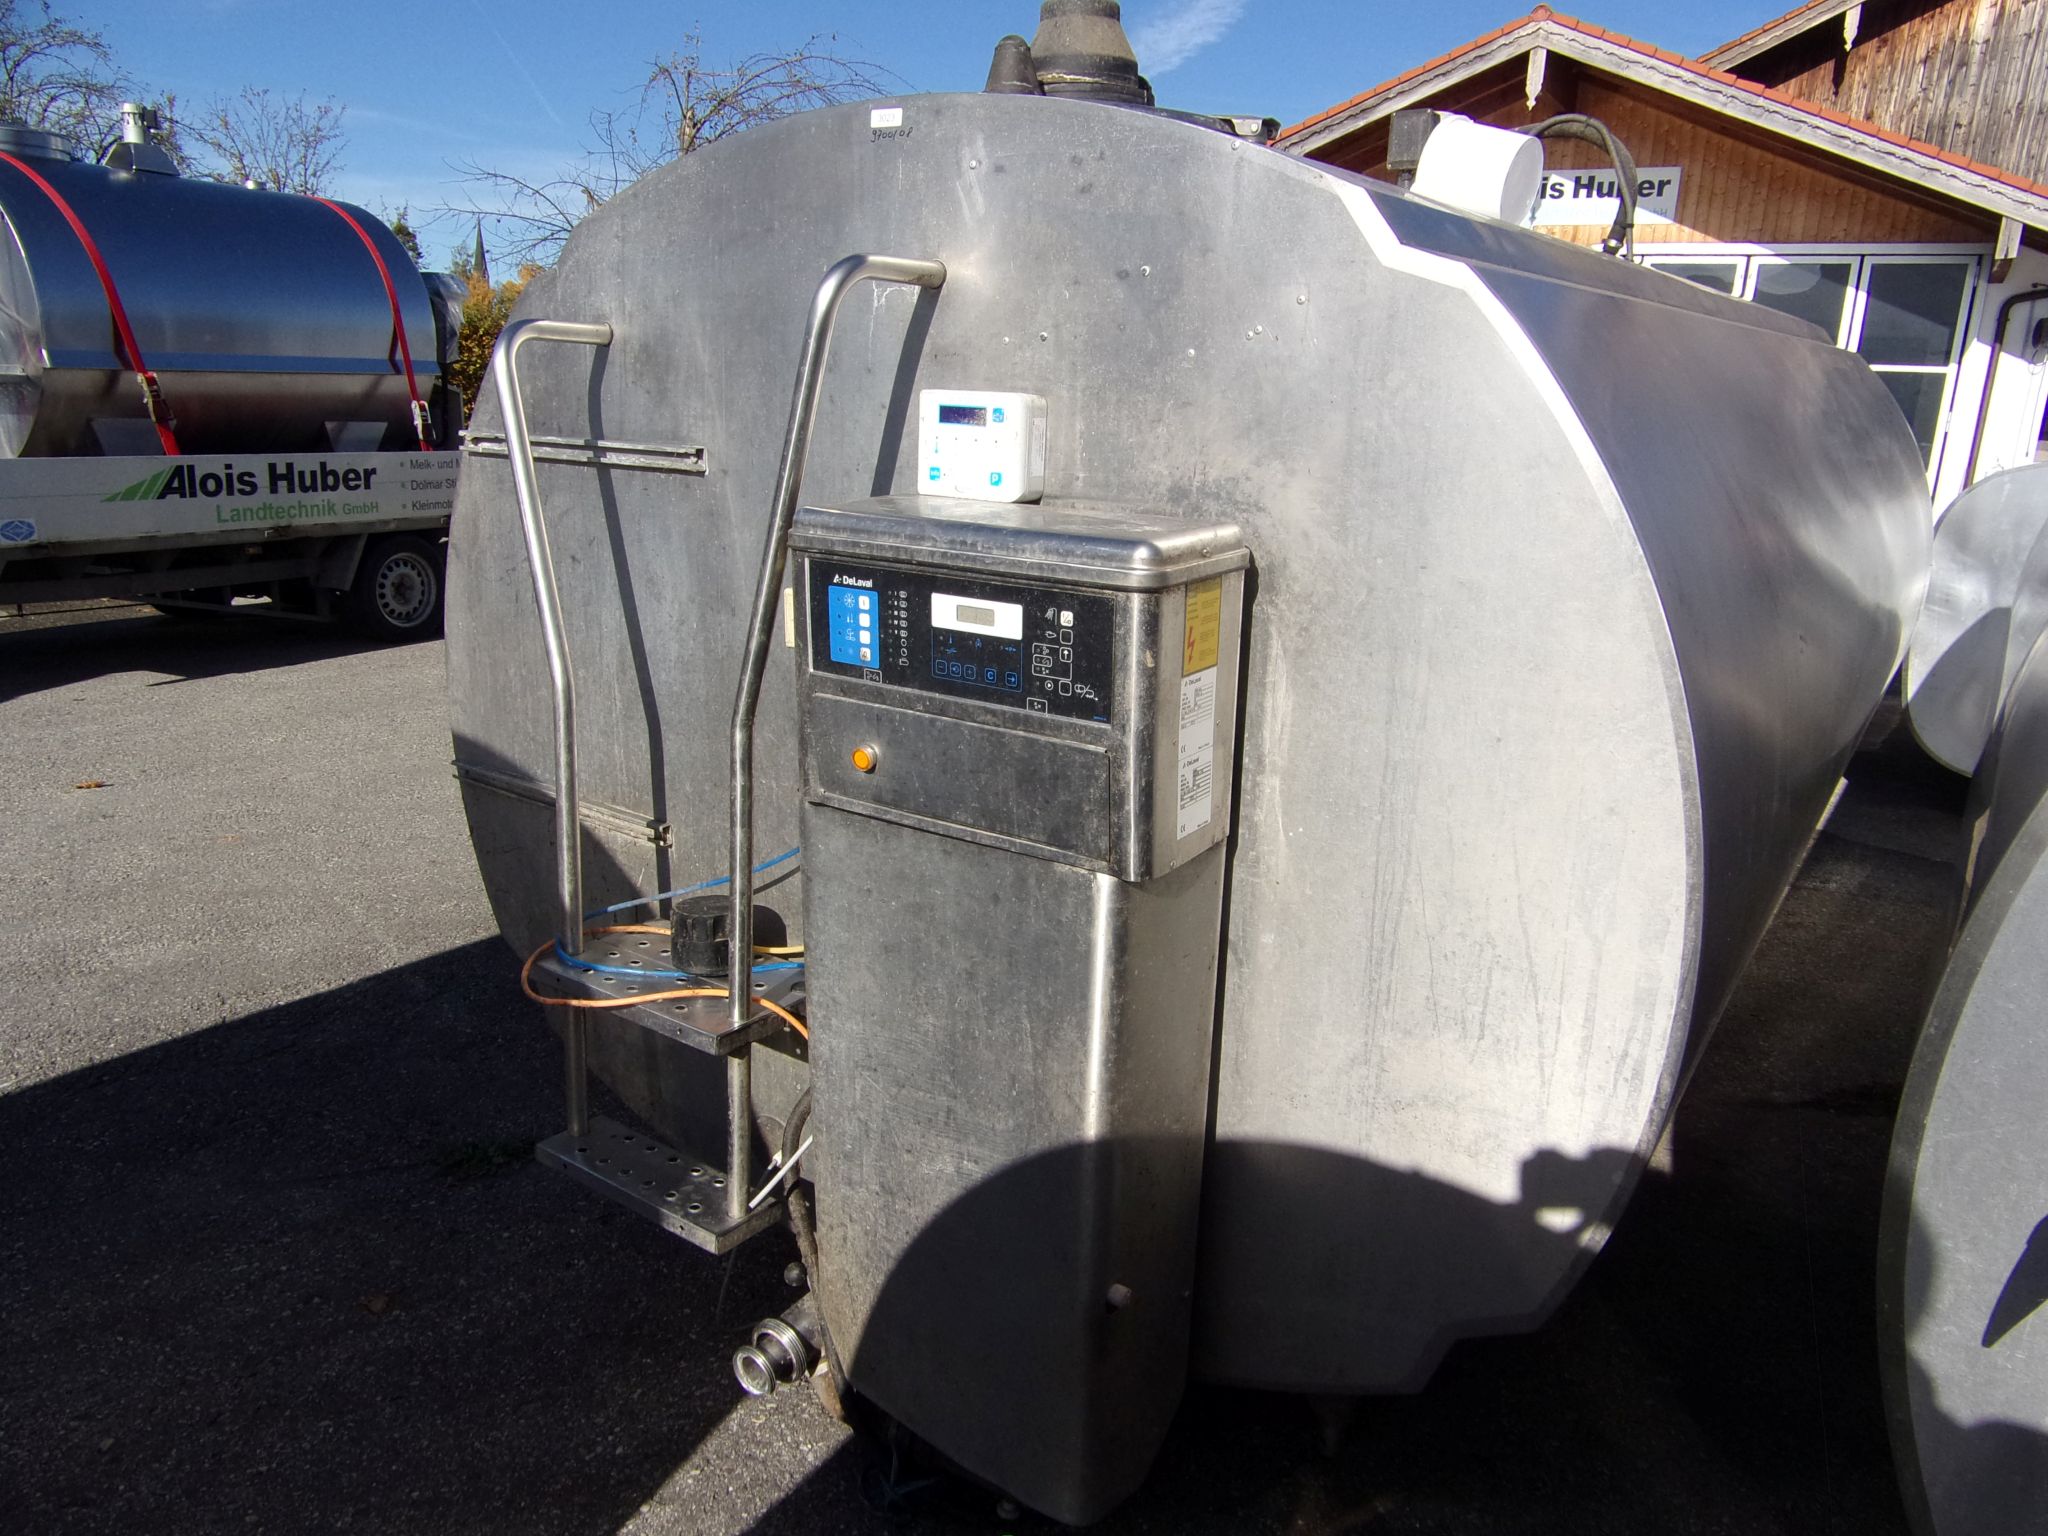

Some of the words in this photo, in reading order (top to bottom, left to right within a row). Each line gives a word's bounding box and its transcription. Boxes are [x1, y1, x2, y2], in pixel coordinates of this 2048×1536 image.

[1572, 175, 1672, 199] Huer
[410, 459, 435, 470] Melk-
[437, 459, 454, 469] und
[157, 463, 259, 500] Alois
[267, 461, 377, 494] Huber
[216, 499, 337, 523] Landtechnik
[342, 501, 379, 515] GmbH
[843, 575, 873, 588] DeLaval
